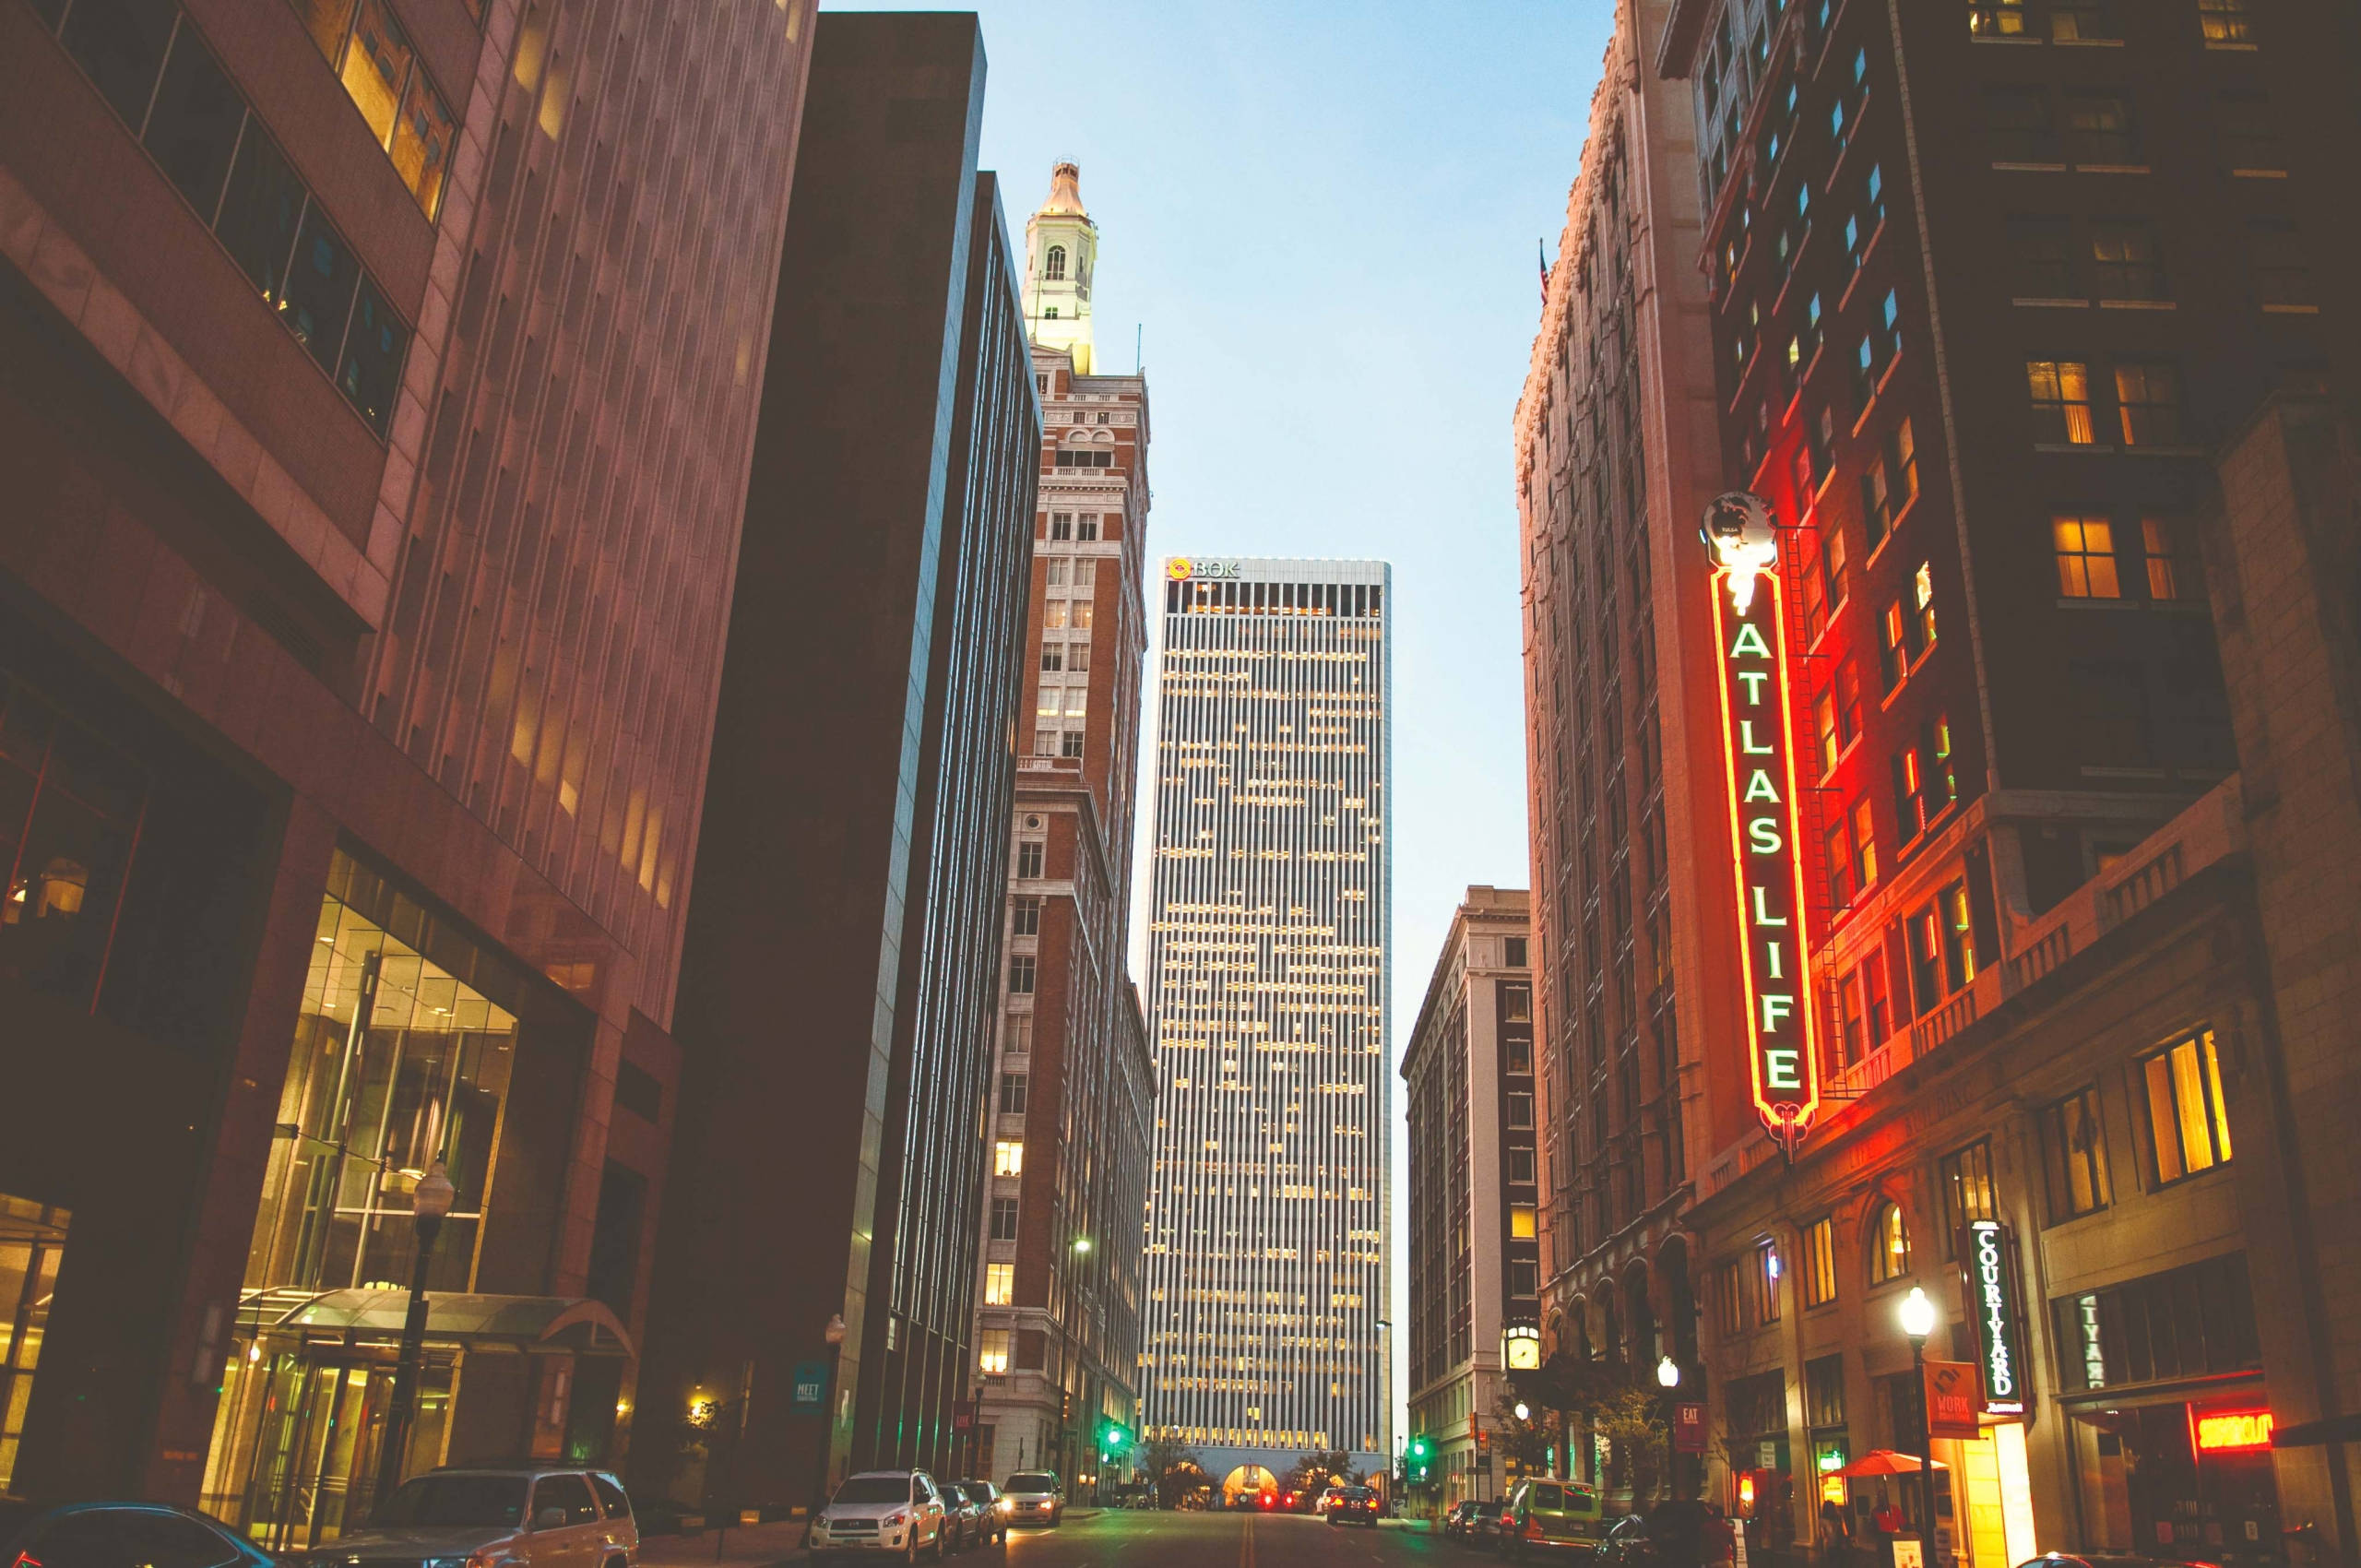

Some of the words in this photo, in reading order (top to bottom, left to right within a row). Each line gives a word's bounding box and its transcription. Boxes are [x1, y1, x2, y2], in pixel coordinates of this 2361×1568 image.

[1193, 561, 1240, 577] BOK
[1730, 623, 1782, 854] ATLAS
[1752, 886, 1800, 1088] LIFE
[1978, 1230, 2012, 1396] COURTYARD
[797, 1384, 819, 1395] MEET
[1937, 1396, 1969, 1413] WORK
[1683, 1408, 1698, 1420] EAT
